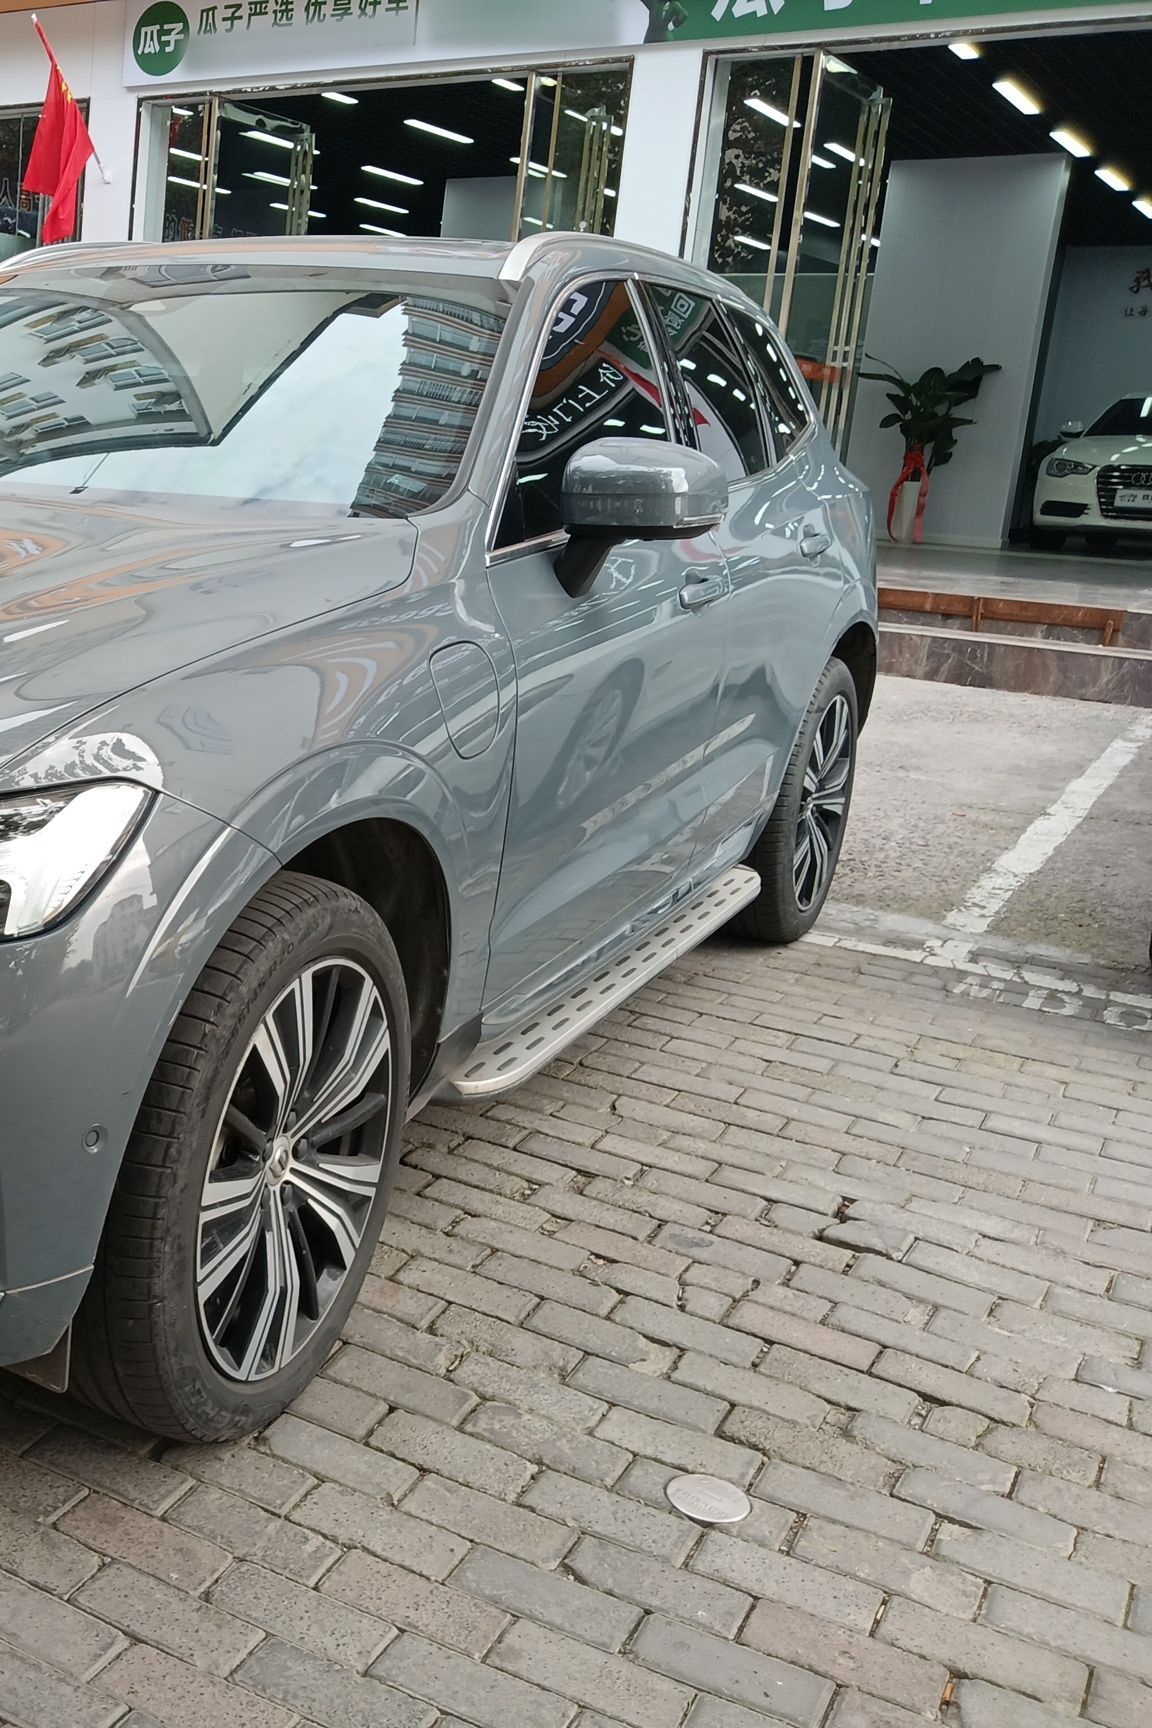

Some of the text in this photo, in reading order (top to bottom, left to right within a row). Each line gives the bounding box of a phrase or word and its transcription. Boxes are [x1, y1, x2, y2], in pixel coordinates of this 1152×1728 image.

[197, 0, 294, 36] 瓜子严选
[138, 22, 185, 55] 瓜子
